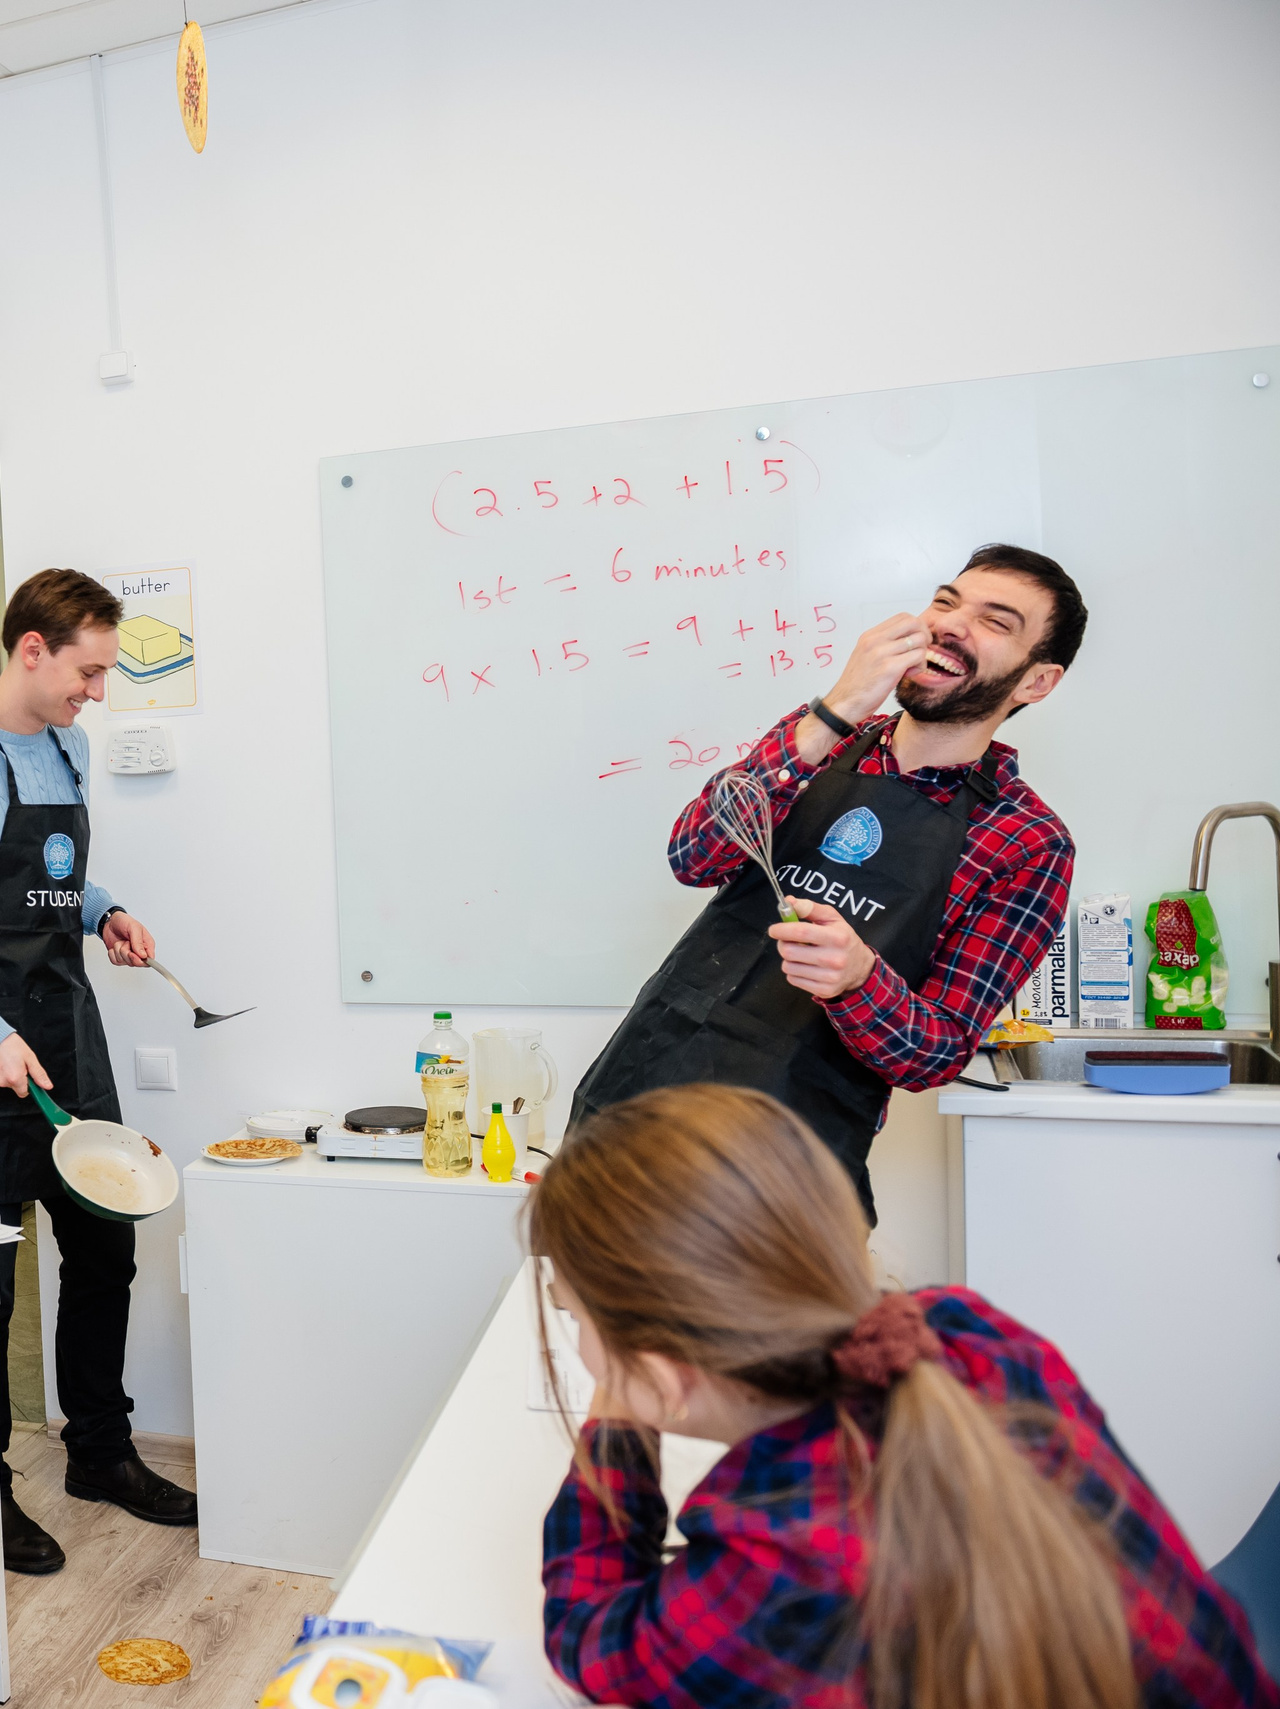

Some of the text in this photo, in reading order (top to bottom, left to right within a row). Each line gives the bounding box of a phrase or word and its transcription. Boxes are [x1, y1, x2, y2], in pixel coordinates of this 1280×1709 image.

[122, 577, 170, 596] butter
[458, 543, 788, 611] 1st = 6 minutes
[422, 662, 449, 702] 9
[532, 639, 589, 676] 1.5
[623, 641, 650, 658] =
[676, 614, 703, 647] 9
[732, 618, 755, 642] +
[774, 603, 837, 638] 4.5
[718, 643, 834, 678] = 13.5
[598, 757, 642, 780] =
[668, 738, 721, 770] 20
[1048, 934, 1070, 1018] parmalat
